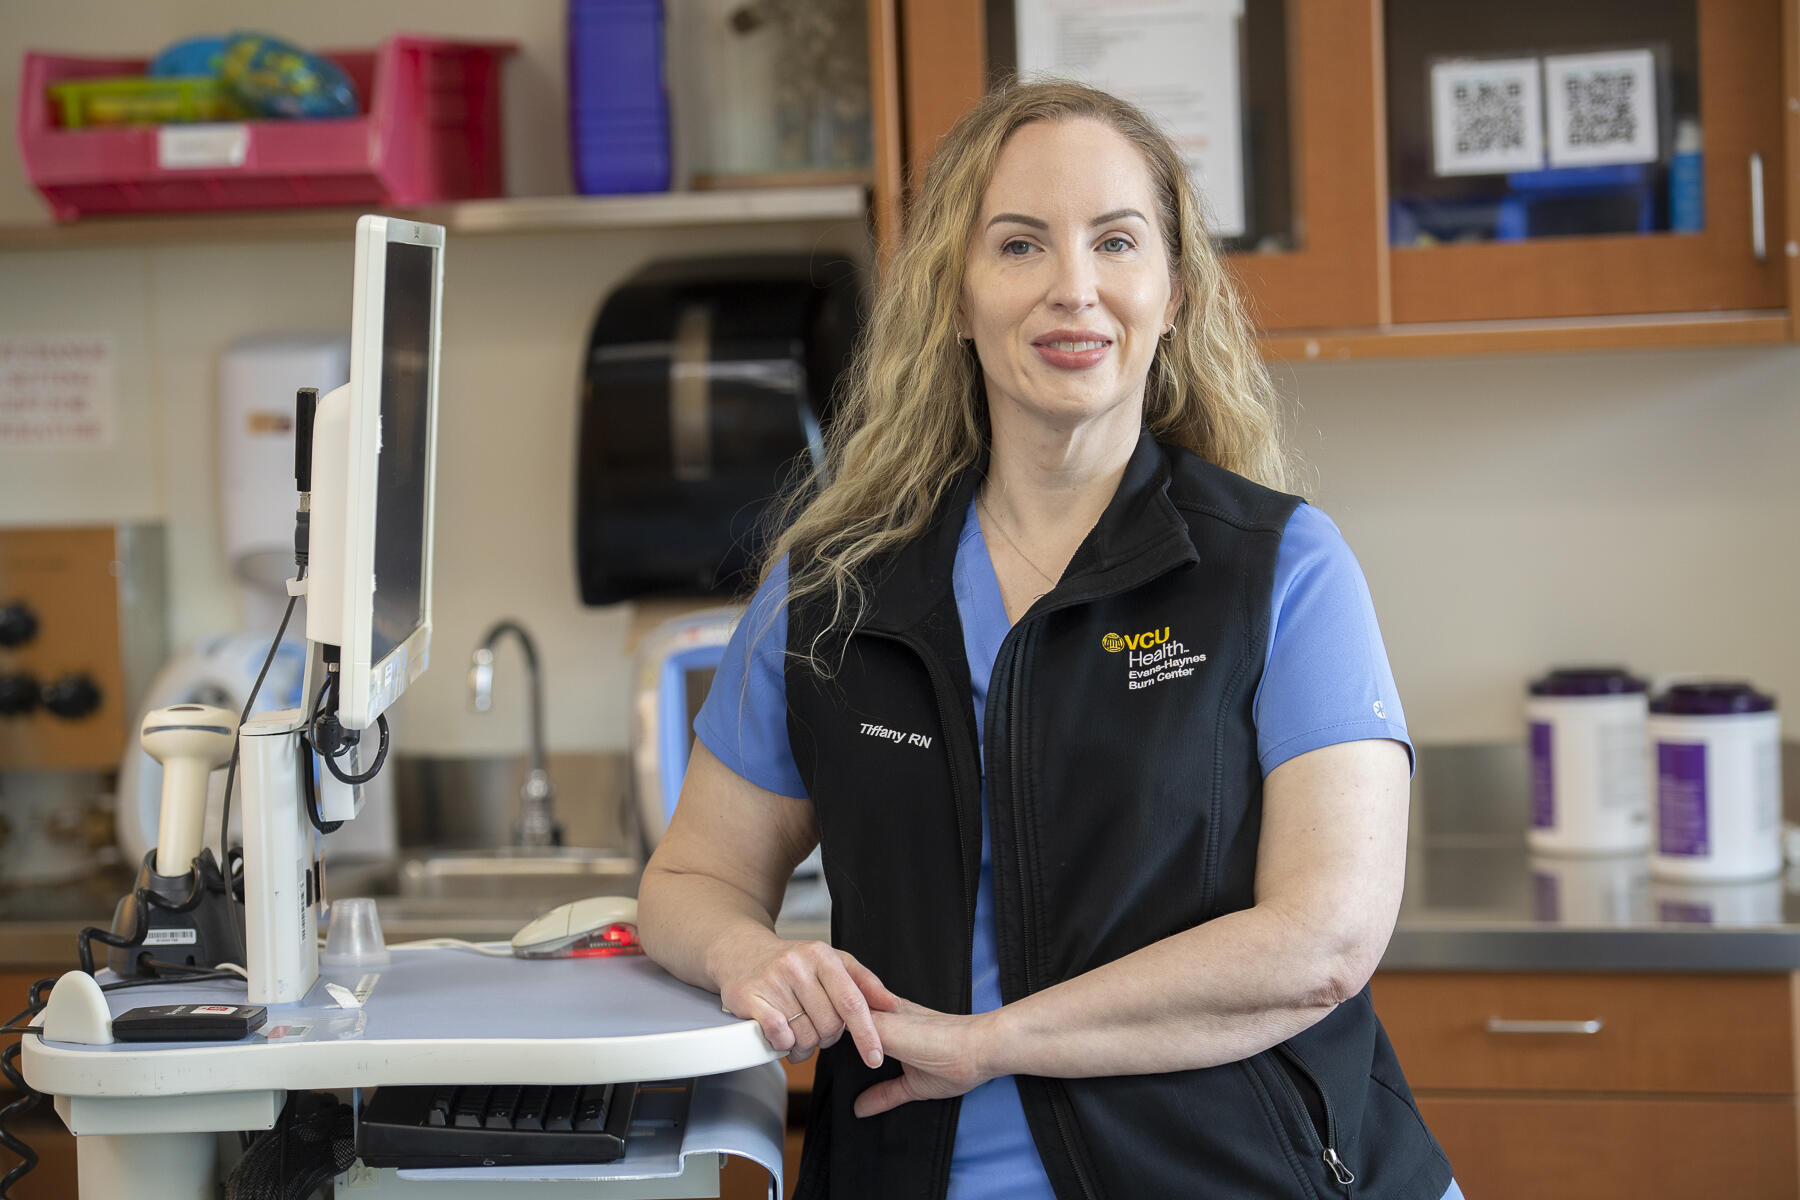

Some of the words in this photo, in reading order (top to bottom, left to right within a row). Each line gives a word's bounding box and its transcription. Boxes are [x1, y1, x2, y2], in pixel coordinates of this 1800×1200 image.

[1124, 626, 1170, 650] VCU
[1128, 640, 1184, 668] Health
[1128, 653, 1206, 679] Evans-Haynes
[1128, 678, 1155, 690] Burn
[1157, 667, 1194, 682] Center
[860, 723, 907, 743] Tiffany
[908, 733, 932, 749] RN
